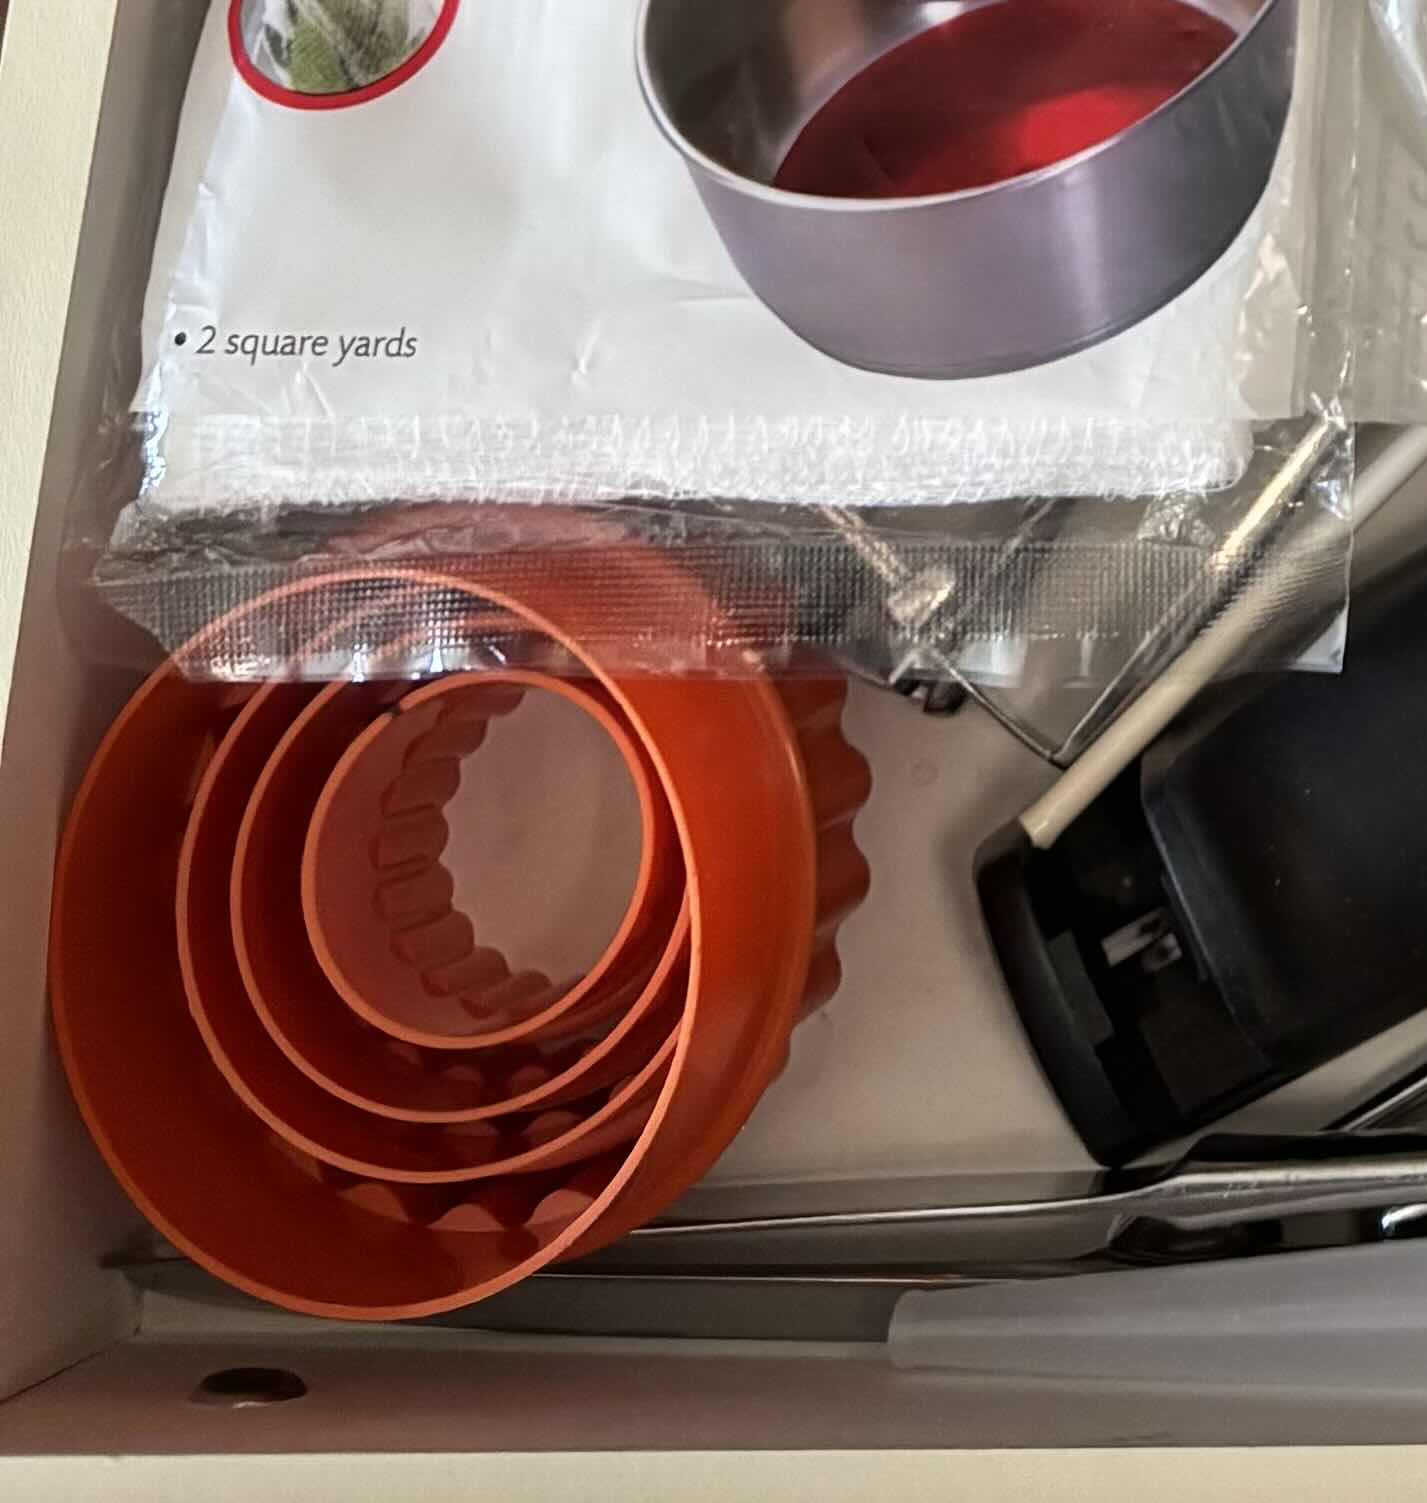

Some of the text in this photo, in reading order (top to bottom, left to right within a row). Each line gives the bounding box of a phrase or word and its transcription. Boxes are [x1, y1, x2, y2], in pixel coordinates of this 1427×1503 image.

[196, 325, 418, 367] 2 square yards
